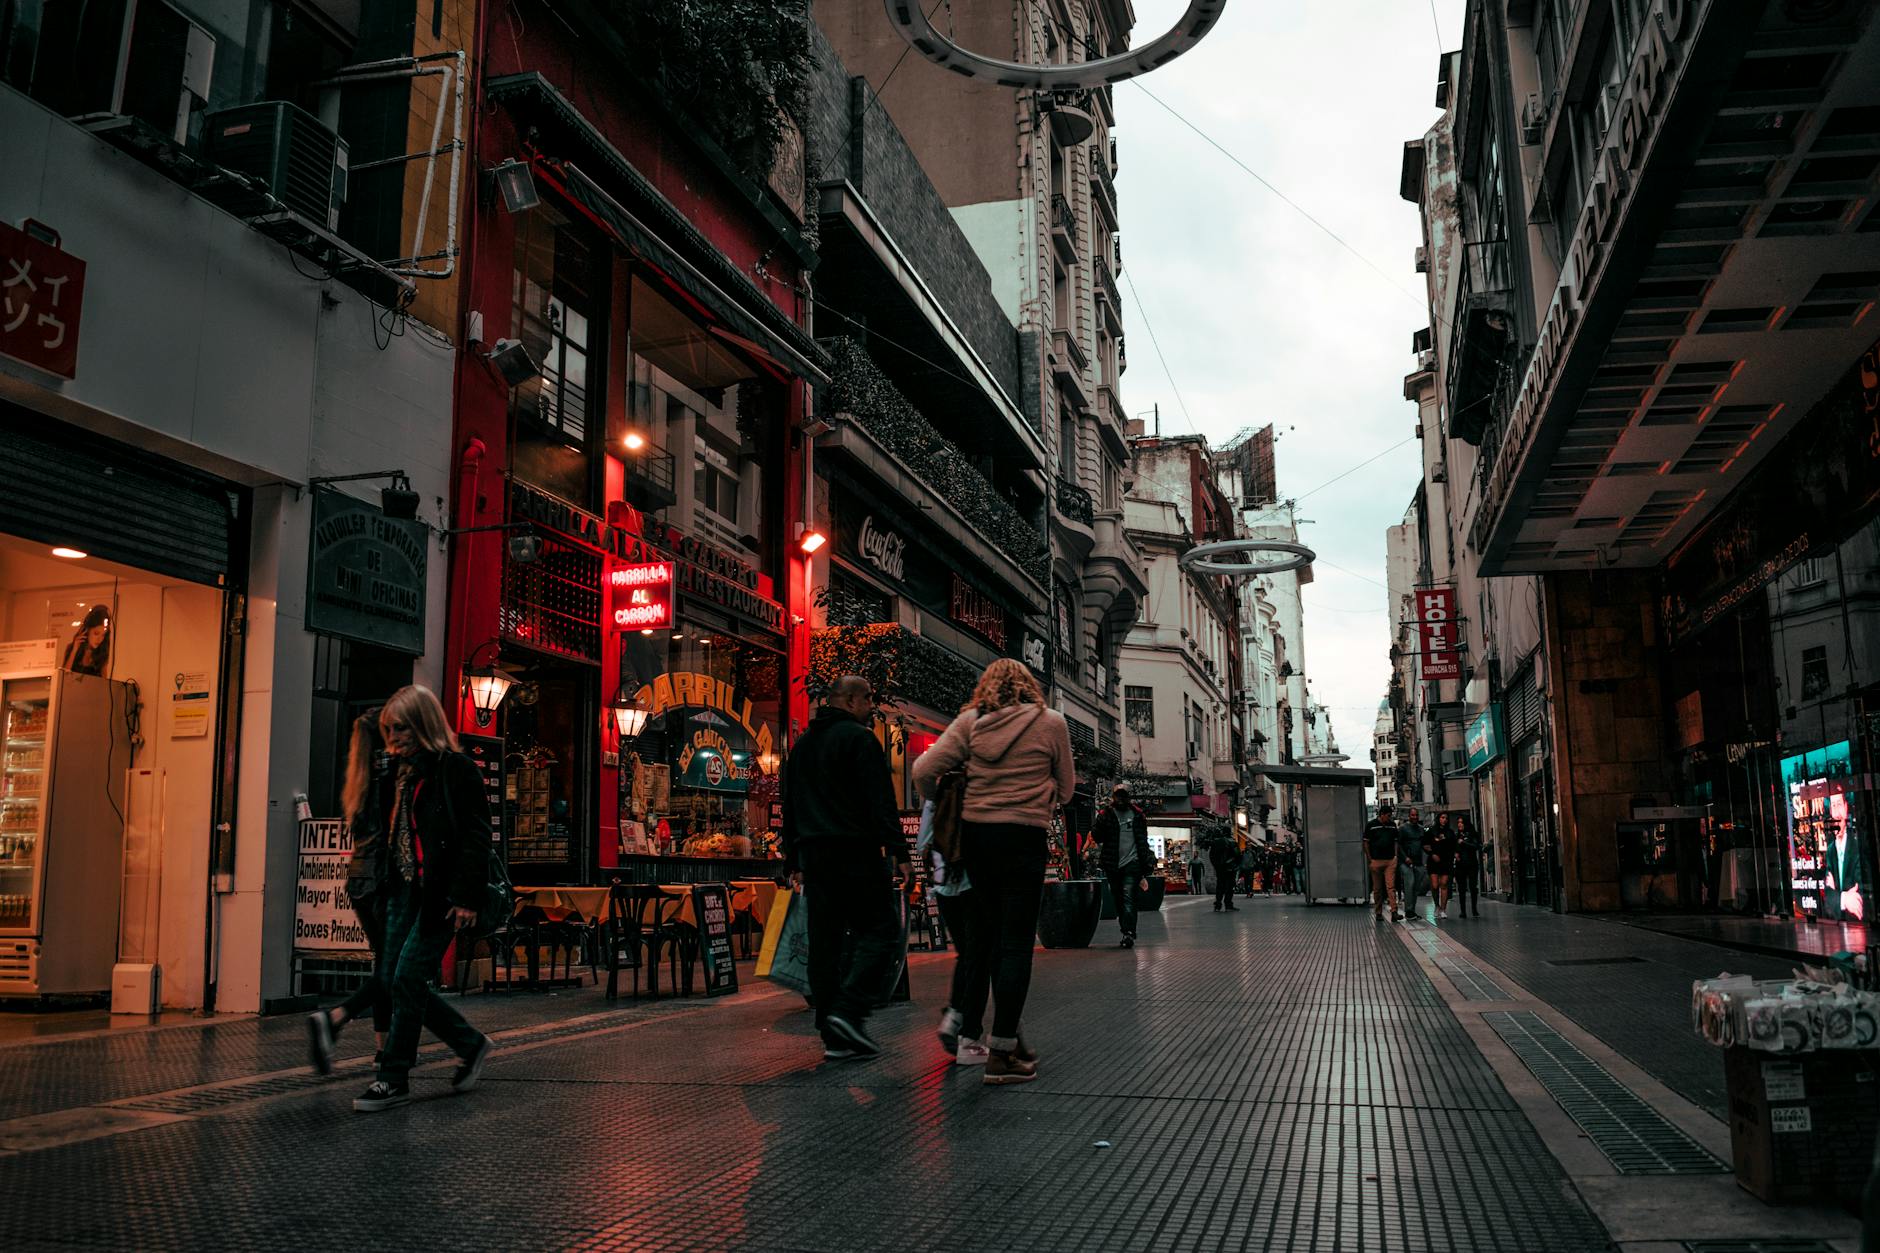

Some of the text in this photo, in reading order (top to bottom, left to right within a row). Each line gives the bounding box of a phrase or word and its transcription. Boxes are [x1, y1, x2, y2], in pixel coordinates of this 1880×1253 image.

[2, 256, 70, 308] メイ
[4, 297, 66, 349] ソウ
[317, 514, 425, 578] ALQUILER TEMPORARIO
[367, 549, 381, 572] DE
[337, 566, 417, 612] MINI OFICINAS
[612, 564, 669, 586] PARRILLA
[632, 589, 650, 604] AL
[615, 603, 665, 624] CARBON
[695, 566, 785, 631] RESTAURANT
[1424, 594, 1449, 665] HOTEL
[633, 671, 773, 755] PARRILLA
[679, 728, 738, 780] EL GAUCHO
[300, 857, 335, 880] Ambiente
[298, 885, 331, 908] Mayor
[296, 918, 365, 943] Boxes Privados
